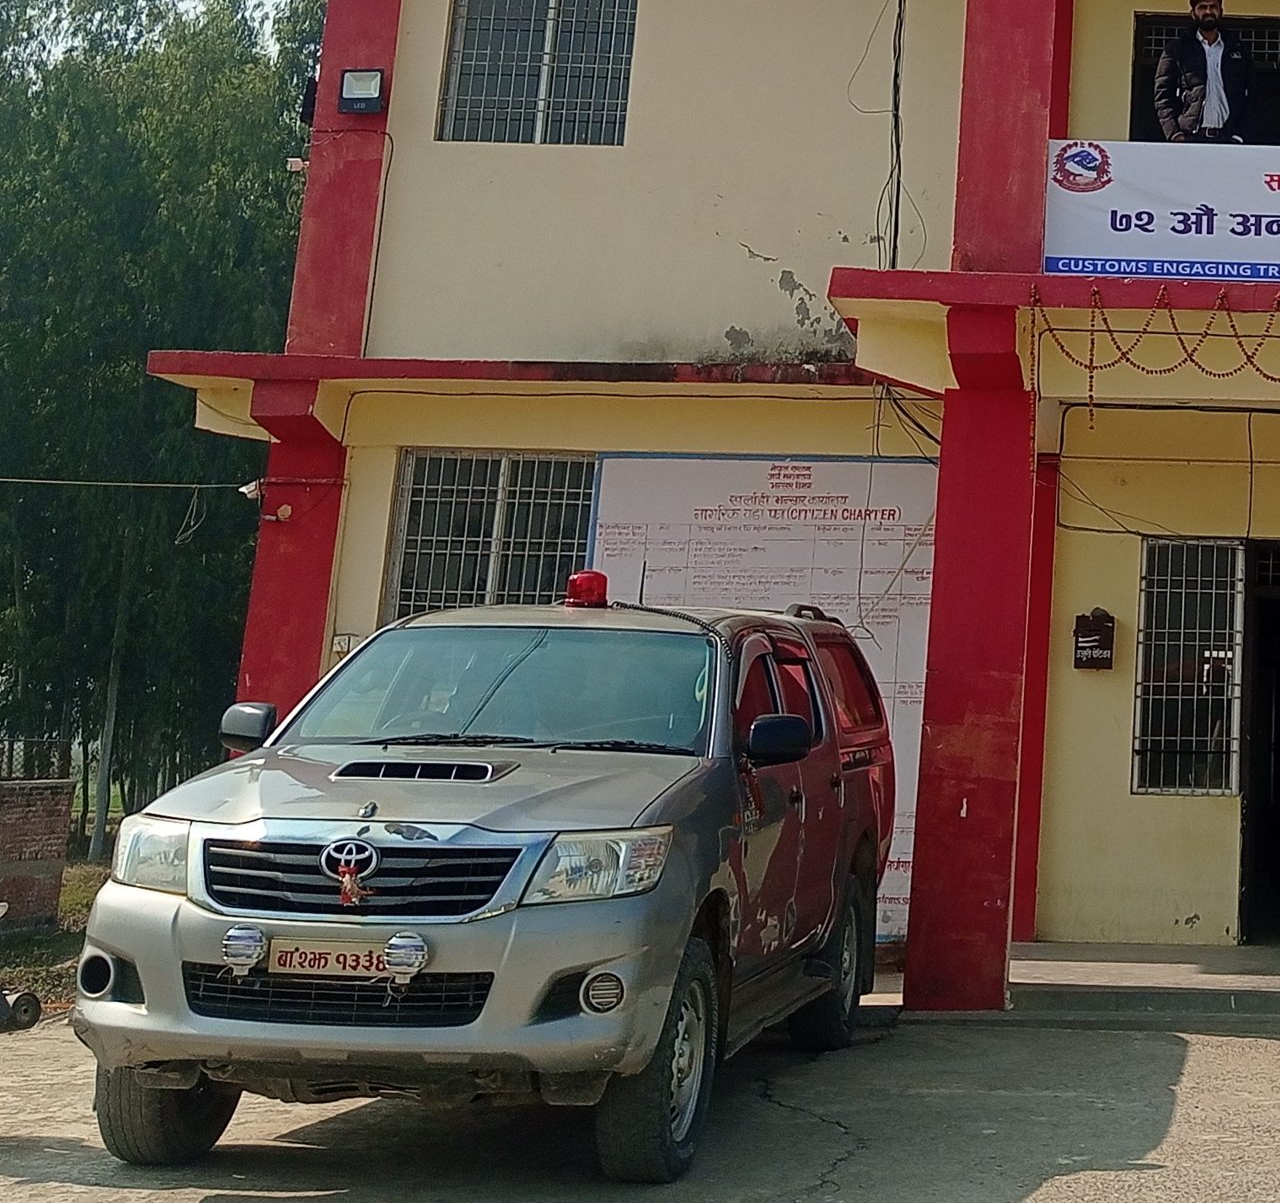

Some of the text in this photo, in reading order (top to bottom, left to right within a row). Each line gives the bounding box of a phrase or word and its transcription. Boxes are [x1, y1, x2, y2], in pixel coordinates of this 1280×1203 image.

[1110, 209, 1155, 233] ७२
[1058, 259, 1147, 273] CUSTOMS
[1153, 263, 1251, 276] ENGAGING
[841, 506, 902, 522] CHARTER)
